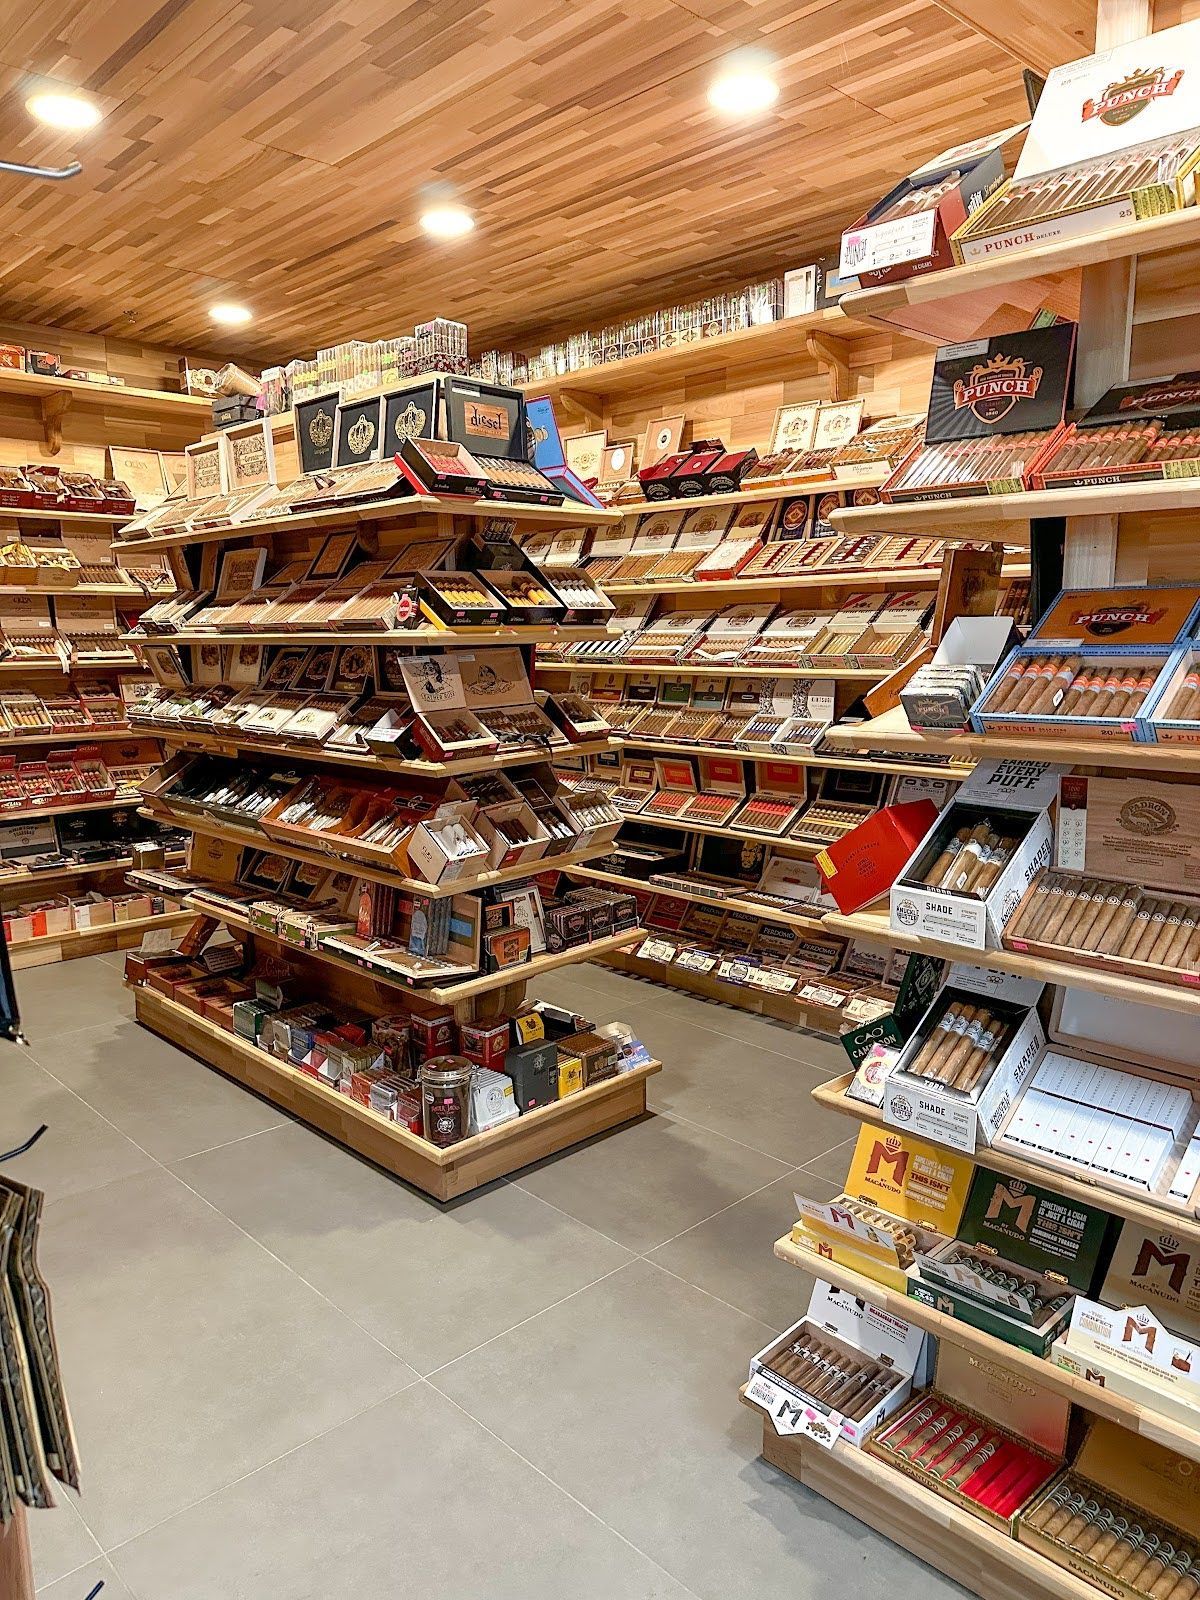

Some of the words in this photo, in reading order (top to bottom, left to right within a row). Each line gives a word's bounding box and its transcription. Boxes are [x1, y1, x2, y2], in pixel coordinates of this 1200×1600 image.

[1092, 82, 1170, 115] PUNCH
[1119, 208, 1132, 219] 25
[984, 232, 1035, 253] PUNCH
[1036, 229, 1061, 240] DELUXE
[962, 380, 1030, 403] PUNCH
[471, 405, 503, 430] diesel
[1084, 475, 1120, 486] PUNCH
[921, 492, 952, 501] PUNCH
[1075, 613, 1150, 625] PUNCH
[917, 705, 946, 714] PUNCH
[997, 725, 1036, 733] PUNCH
[996, 764, 1047, 777] EVERY
[987, 774, 1039, 789] PUFF.
[1024, 838, 1052, 881] SHADED
[925, 901, 953, 915] SHADE
[763, 927, 795, 939] PERDOMO
[803, 943, 836, 955] PERDOMO
[854, 1025, 884, 1045] CAO
[1014, 1035, 1040, 1078] SHADED
[924, 1080, 945, 1091] TORO
[919, 1101, 946, 1116] SHADE
[866, 1140, 909, 1187] M
[865, 1176, 901, 1195] MACANUDO
[911, 1172, 929, 1185] THIS
[929, 1178, 951, 1192] ISN'T
[985, 1182, 1037, 1234] M
[1041, 1199, 1067, 1217] SOMETIMES
[1072, 1210, 1088, 1223] CIGAR
[830, 1207, 855, 1231] M
[1038, 1207, 1045, 1216] IS
[1046, 1210, 1061, 1222] JUST
[1066, 1217, 1085, 1230] CIGAR
[982, 1220, 1025, 1241] MACANUDO
[1038, 1218, 1057, 1232] THIS
[1058, 1224, 1083, 1240] ISN'T
[819, 1242, 833, 1260] M
[1042, 1241, 1059, 1253] CREAM
[1058, 1235, 1080, 1250] TOBACCO
[1132, 1238, 1191, 1295] M
[1129, 1279, 1180, 1303] MACANUDO
[826, 1295, 863, 1319] MACANUDO
[936, 1296, 955, 1317] M
[1091, 1310, 1102, 1320] THE
[1081, 1311, 1114, 1329] PERFECT
[886, 1324, 906, 1340] FLAVOR
[1122, 1316, 1157, 1354] M
[969, 1356, 1037, 1397] MACANUDO
[1085, 1368, 1106, 1388] M
[777, 1399, 803, 1428] M
[894, 1460, 939, 1491] MACANUDO
[1068, 1560, 1125, 1598] MACANUDO
